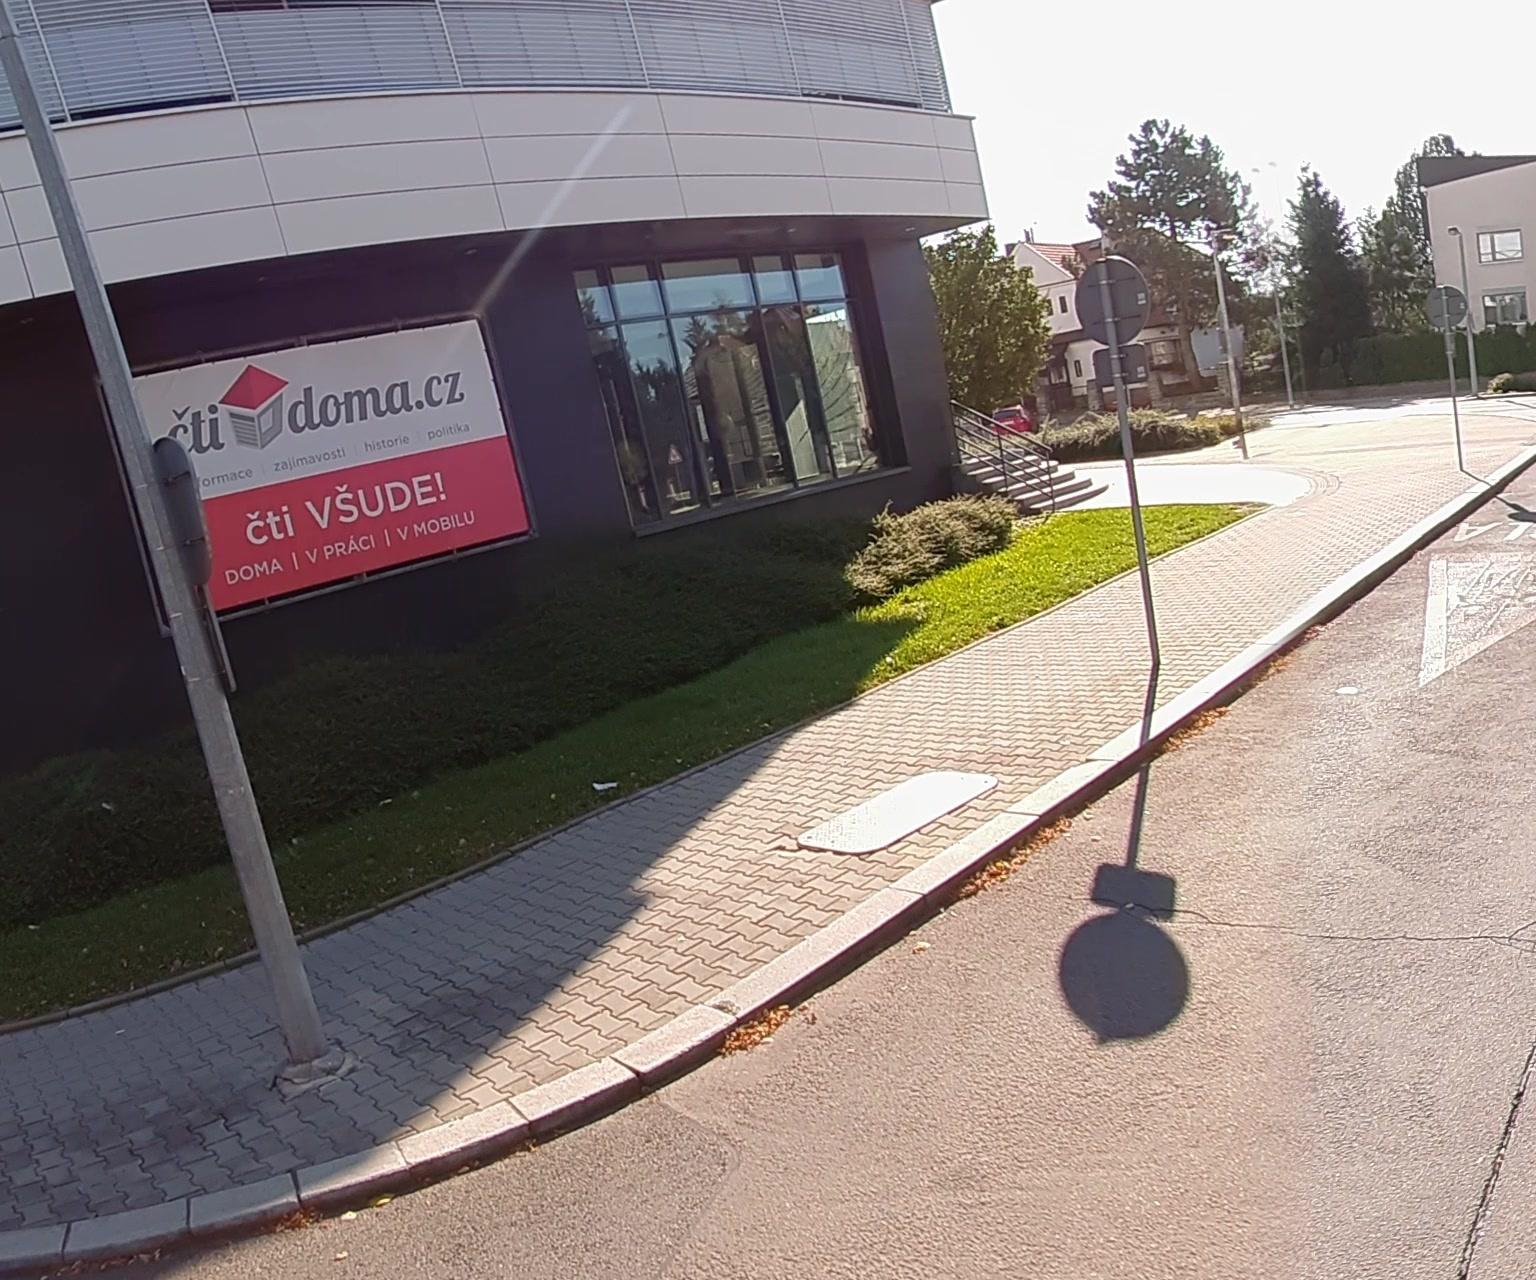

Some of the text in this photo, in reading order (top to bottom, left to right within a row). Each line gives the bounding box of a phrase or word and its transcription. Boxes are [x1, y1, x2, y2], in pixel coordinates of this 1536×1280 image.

[288, 372, 465, 434] doma.cz
[364, 434, 410, 453] historie
[427, 422, 470, 441] politika
[246, 471, 447, 545] čti VŠUDE!
[225, 510, 476, 585] DOMA V PRÁCI V MOBILU
